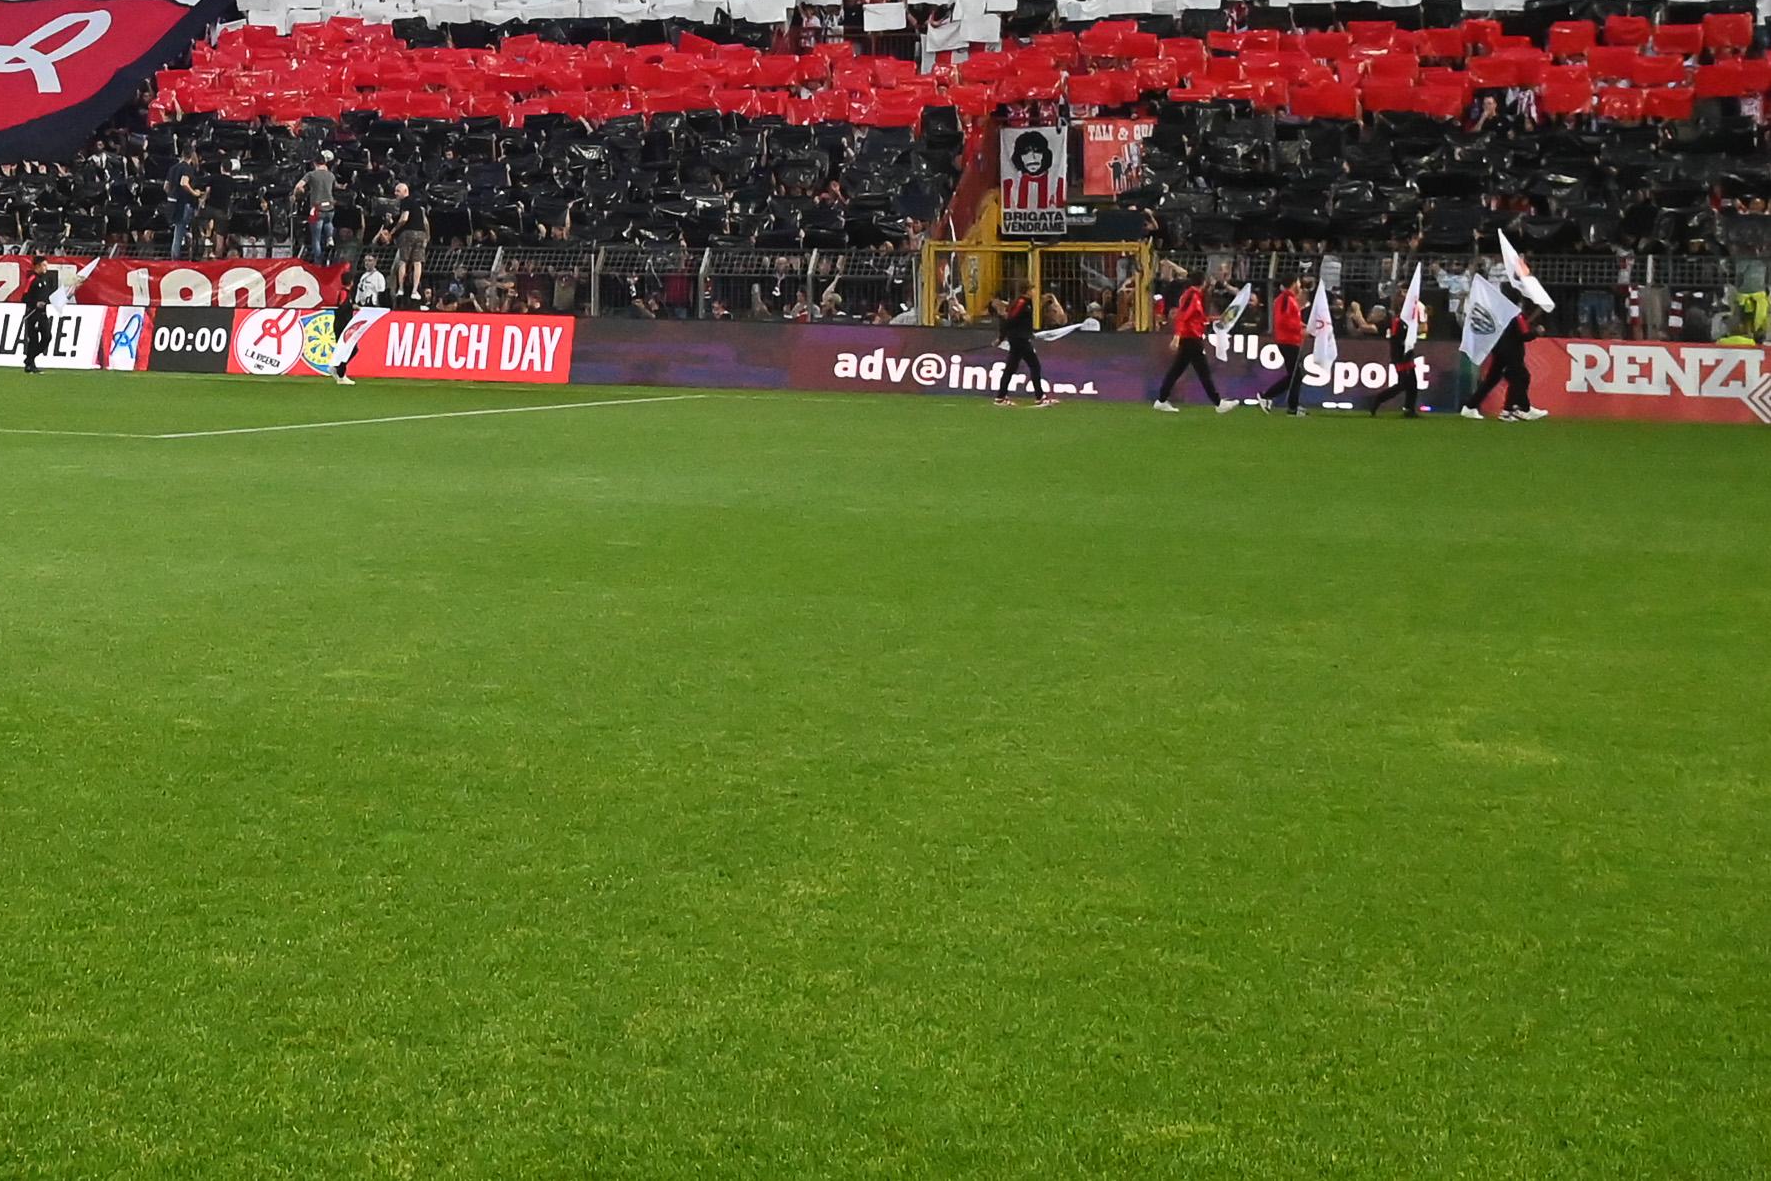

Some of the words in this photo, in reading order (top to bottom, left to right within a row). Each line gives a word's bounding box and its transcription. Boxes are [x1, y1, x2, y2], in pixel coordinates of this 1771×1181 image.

[1003, 212, 1064, 222] BRIGATA
[1004, 222, 1064, 232] VENDRAME
[154, 326, 228, 353] 00:00
[385, 322, 491, 370] MATCH
[500, 325, 563, 372] DAY
